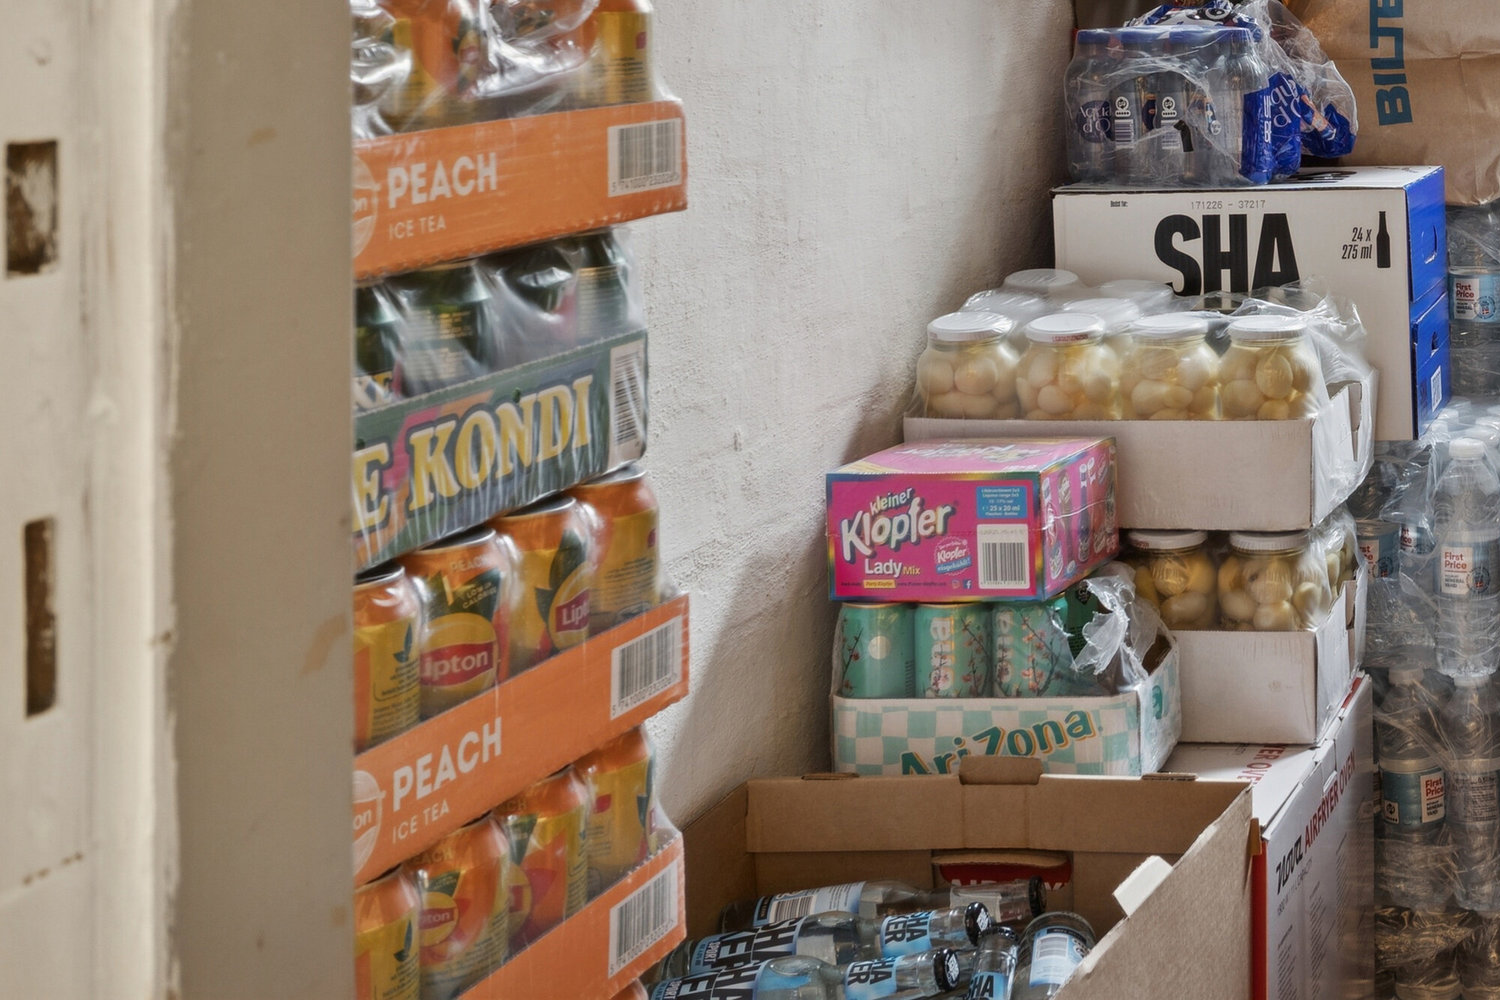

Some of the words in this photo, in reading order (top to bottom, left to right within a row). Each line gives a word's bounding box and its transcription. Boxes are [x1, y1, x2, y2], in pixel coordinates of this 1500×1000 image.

[387, 152, 498, 210] PEACH
[1190, 201, 1224, 210] 171226
[1237, 199, 1267, 209] 37217
[388, 219, 415, 241] ICE
[419, 215, 447, 234] TEA
[1351, 226, 1365, 243] 24
[1364, 231, 1372, 242] x
[1153, 212, 1301, 298] SHA
[1341, 243, 1360, 261] 275
[1360, 243, 1372, 260] ml
[1455, 282, 1473, 291] First
[1455, 290, 1475, 299] Price
[408, 374, 593, 512] KONDI
[870, 487, 914, 516] kleiner
[841, 496, 953, 562] Klopfer
[936, 547, 967, 564] Klopfer
[1444, 551, 1465, 561] First
[1444, 560, 1467, 570] Price
[864, 558, 903, 578] Lady
[902, 565, 921, 575] Mix
[901, 709, 1096, 777] AriZona
[393, 716, 502, 813] PEACH
[1425, 777, 1443, 789] First
[1425, 786, 1444, 797] Price
[1304, 783, 1340, 855] AIRFRYER
[1339, 747, 1357, 796] OVEN
[392, 814, 418, 845] ICE
[423, 799, 450, 826] TEA
